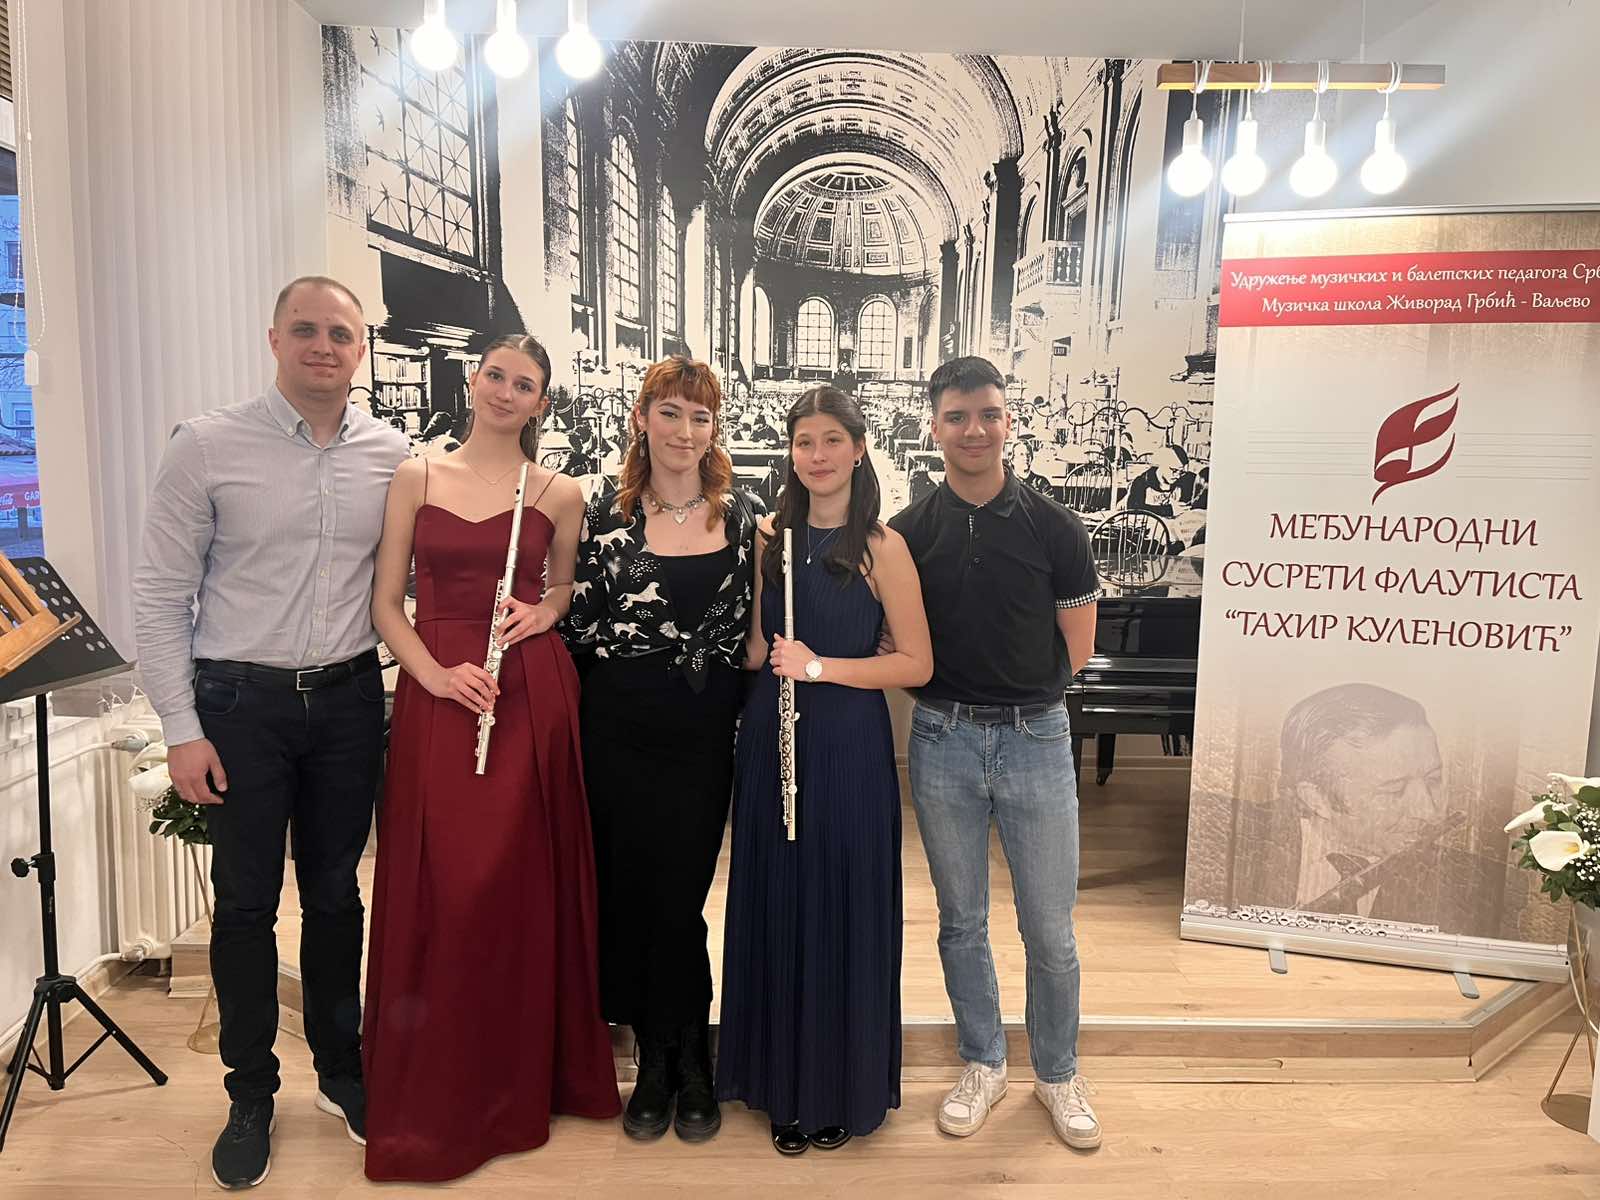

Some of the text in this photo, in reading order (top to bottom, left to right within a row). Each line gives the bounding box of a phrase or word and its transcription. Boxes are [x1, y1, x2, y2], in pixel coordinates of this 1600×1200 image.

[1230, 271, 1306, 291] Удружење
[1310, 271, 1388, 288] музичких
[1392, 271, 1403, 282] и
[1407, 264, 1494, 281] балетских
[1498, 268, 1568, 283] педагога
[1261, 297, 1330, 318] Музичка
[1334, 299, 1382, 311] школа
[1386, 294, 1462, 314] Живорад
[1467, 290, 1517, 314] Грбић
[1532, 292, 1591, 309] Ваљево
[1269, 513, 1539, 553] МЕЂУНАРОДНИ
[1222, 560, 1583, 601] СУСРЕТИ ФЛАУТИСТА
[1225, 608, 1573, 652] “ТАХИР КУЛЕНОВИЋ”
